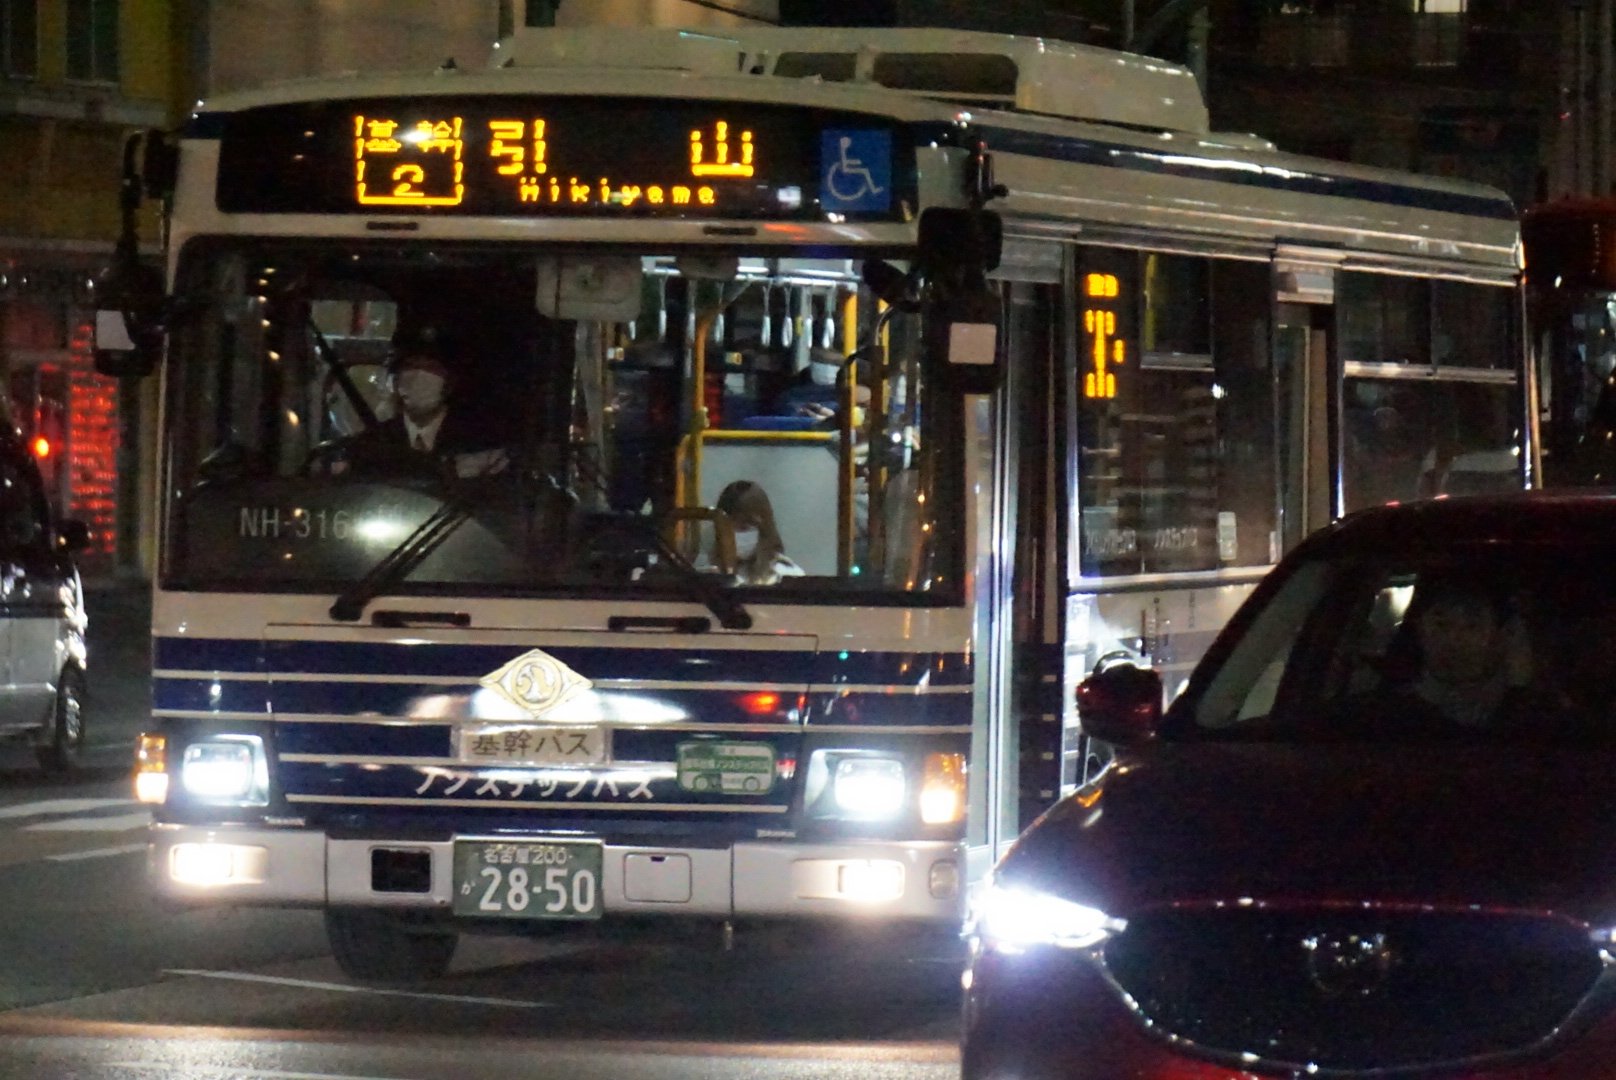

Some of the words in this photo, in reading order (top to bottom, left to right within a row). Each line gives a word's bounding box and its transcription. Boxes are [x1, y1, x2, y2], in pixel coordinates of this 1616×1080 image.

[393, 164, 424, 197] 2
[240, 506, 349, 540] NH-316
[471, 728, 591, 757] 基幹バス
[479, 866, 596, 913] 28-50
